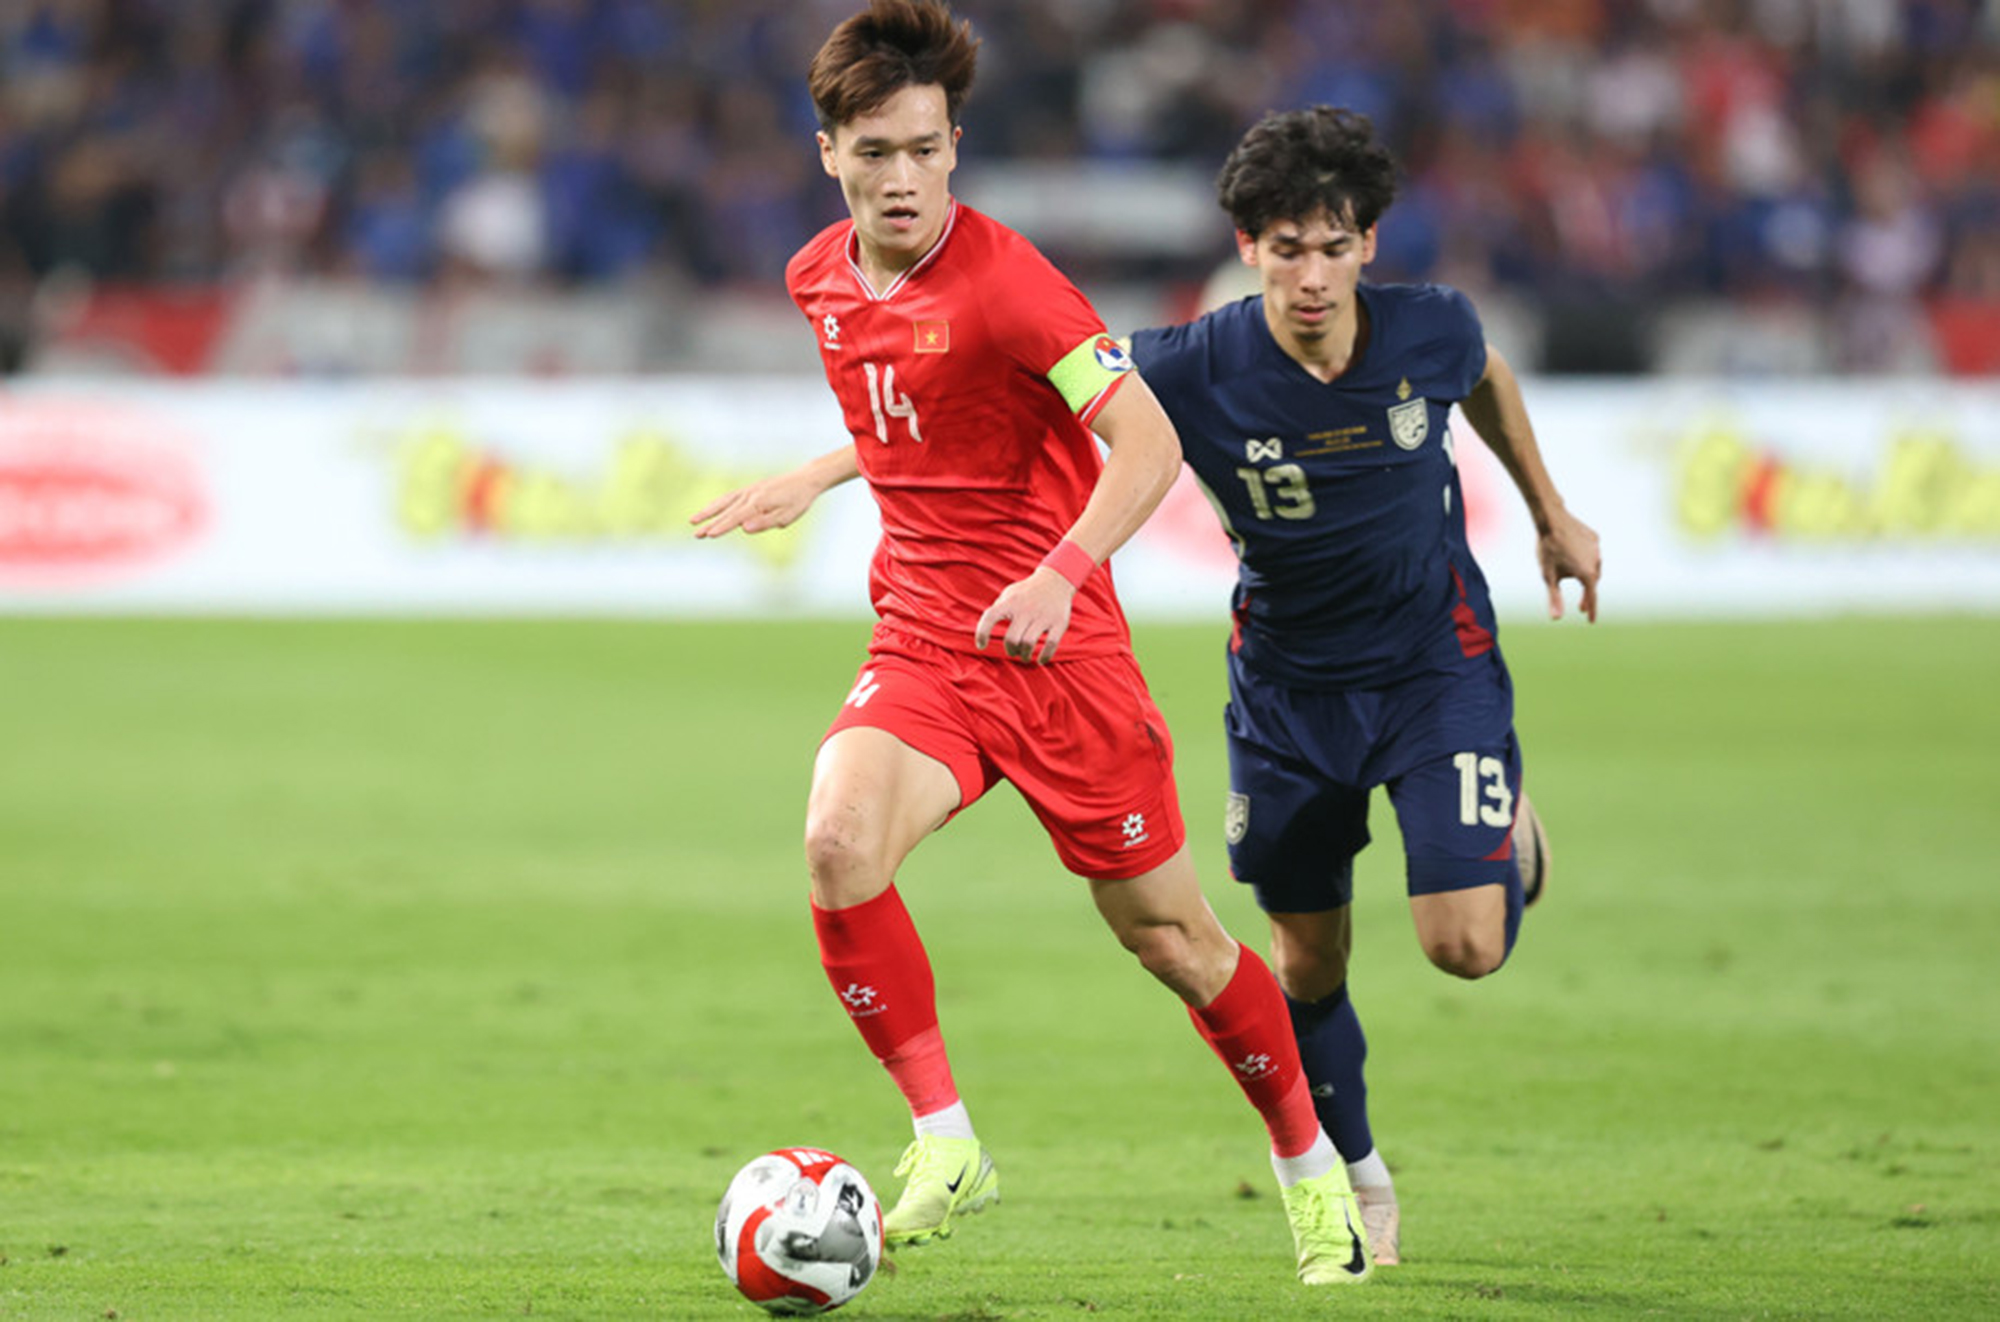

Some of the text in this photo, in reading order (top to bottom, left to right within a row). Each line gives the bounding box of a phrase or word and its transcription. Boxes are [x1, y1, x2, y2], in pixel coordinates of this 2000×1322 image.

[864, 362, 923, 444] 14
[1236, 464, 1316, 520] 13
[1453, 752, 1513, 828] 13
